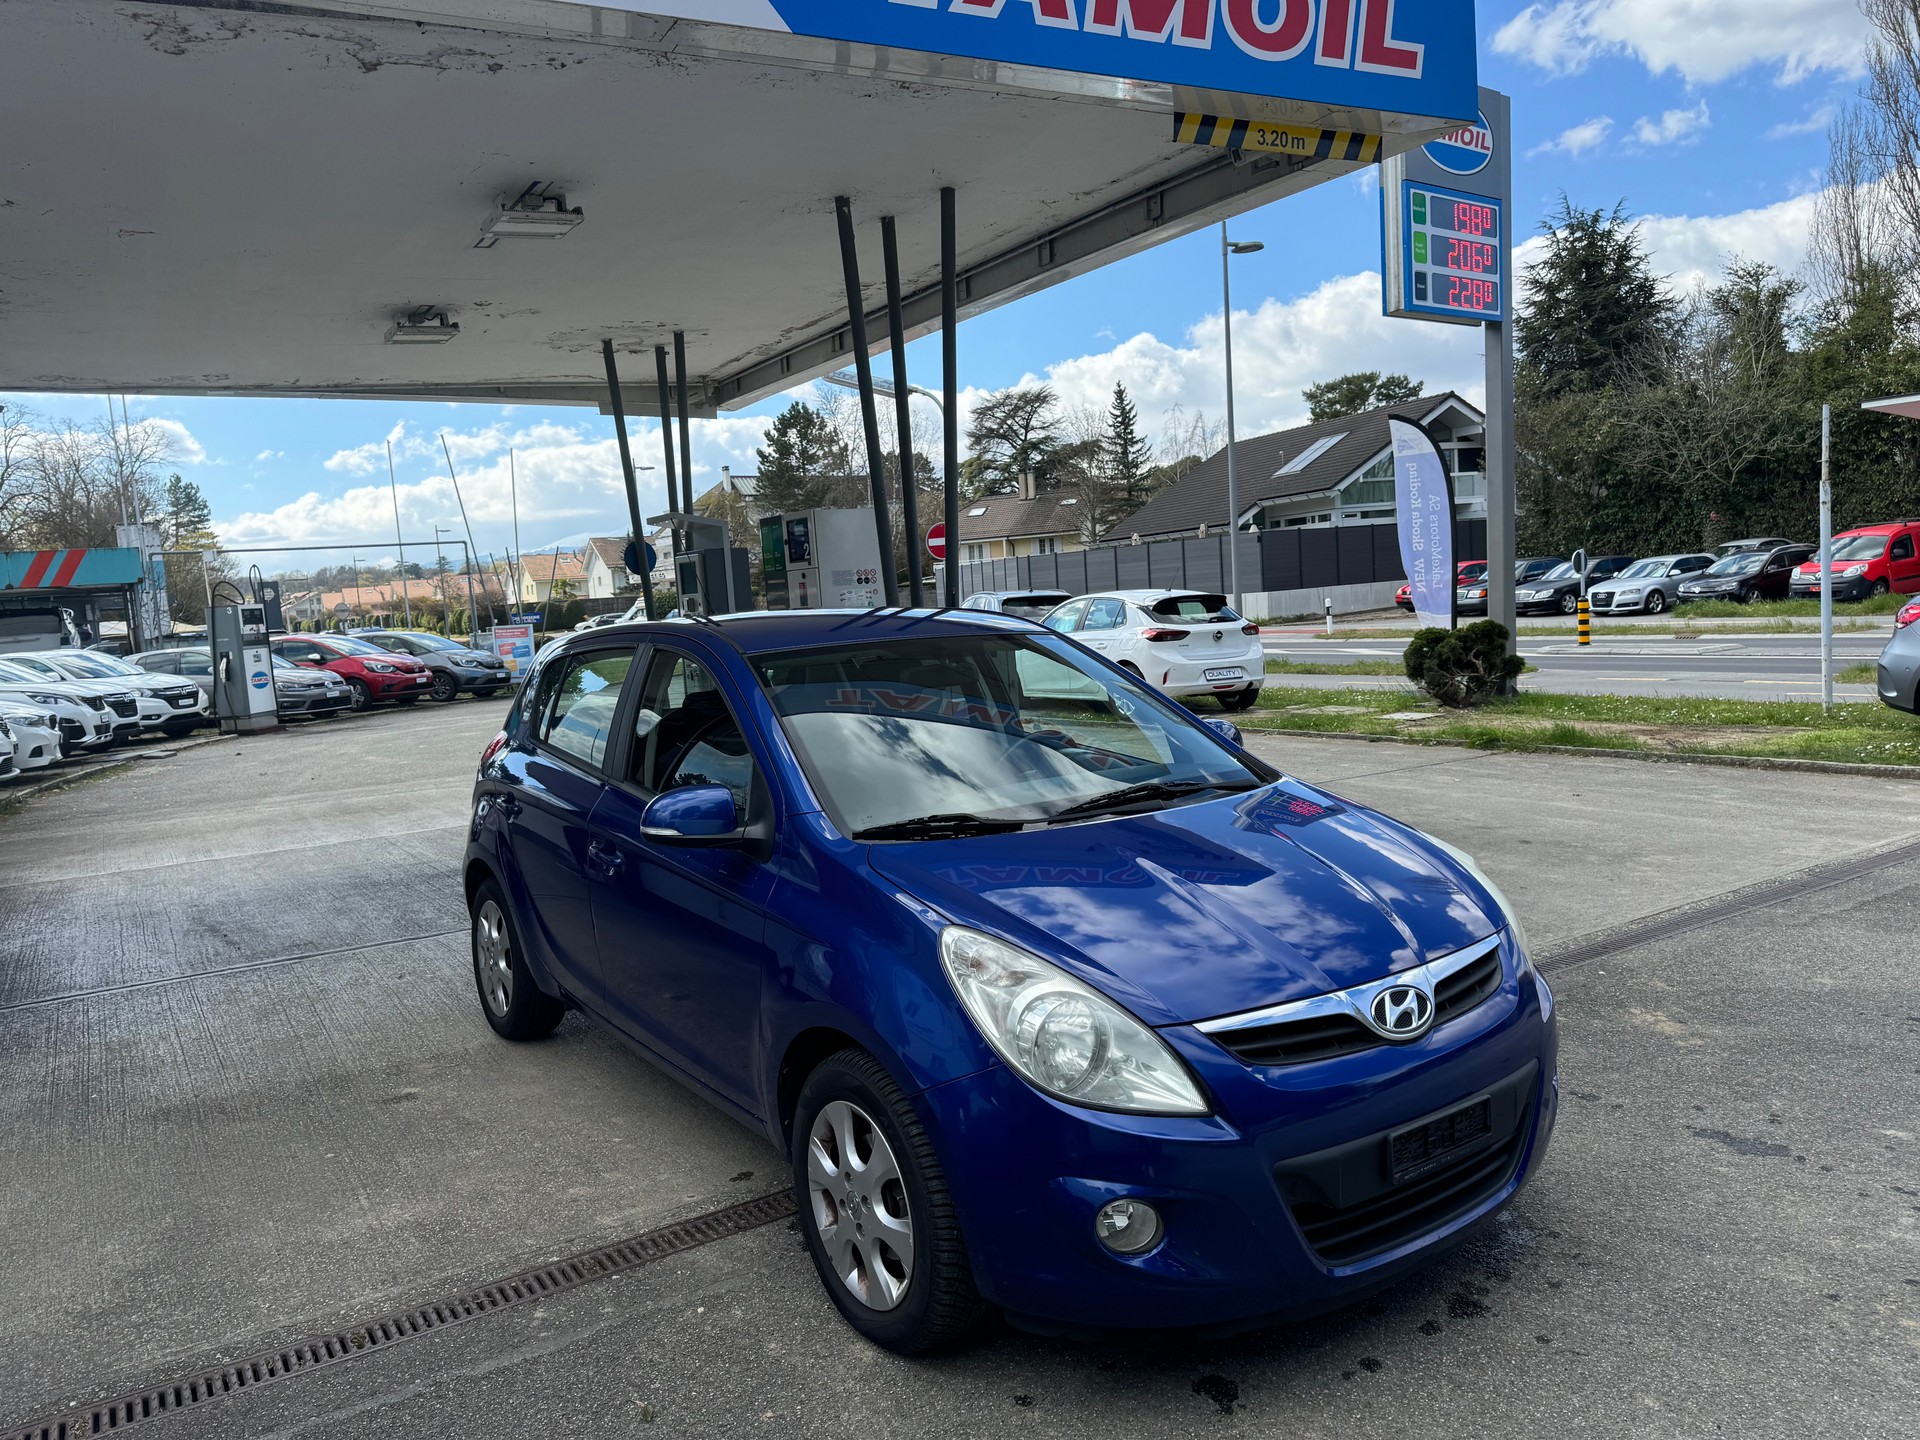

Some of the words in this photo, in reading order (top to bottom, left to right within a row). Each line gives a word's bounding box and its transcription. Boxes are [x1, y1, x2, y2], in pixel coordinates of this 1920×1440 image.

[1257, 128, 1288, 148] 3.20
[1291, 136, 1305, 150] m
[1440, 127, 1491, 152] MOIL
[803, 543, 810, 559] 2
[1208, 670, 1235, 678] QUALITY
